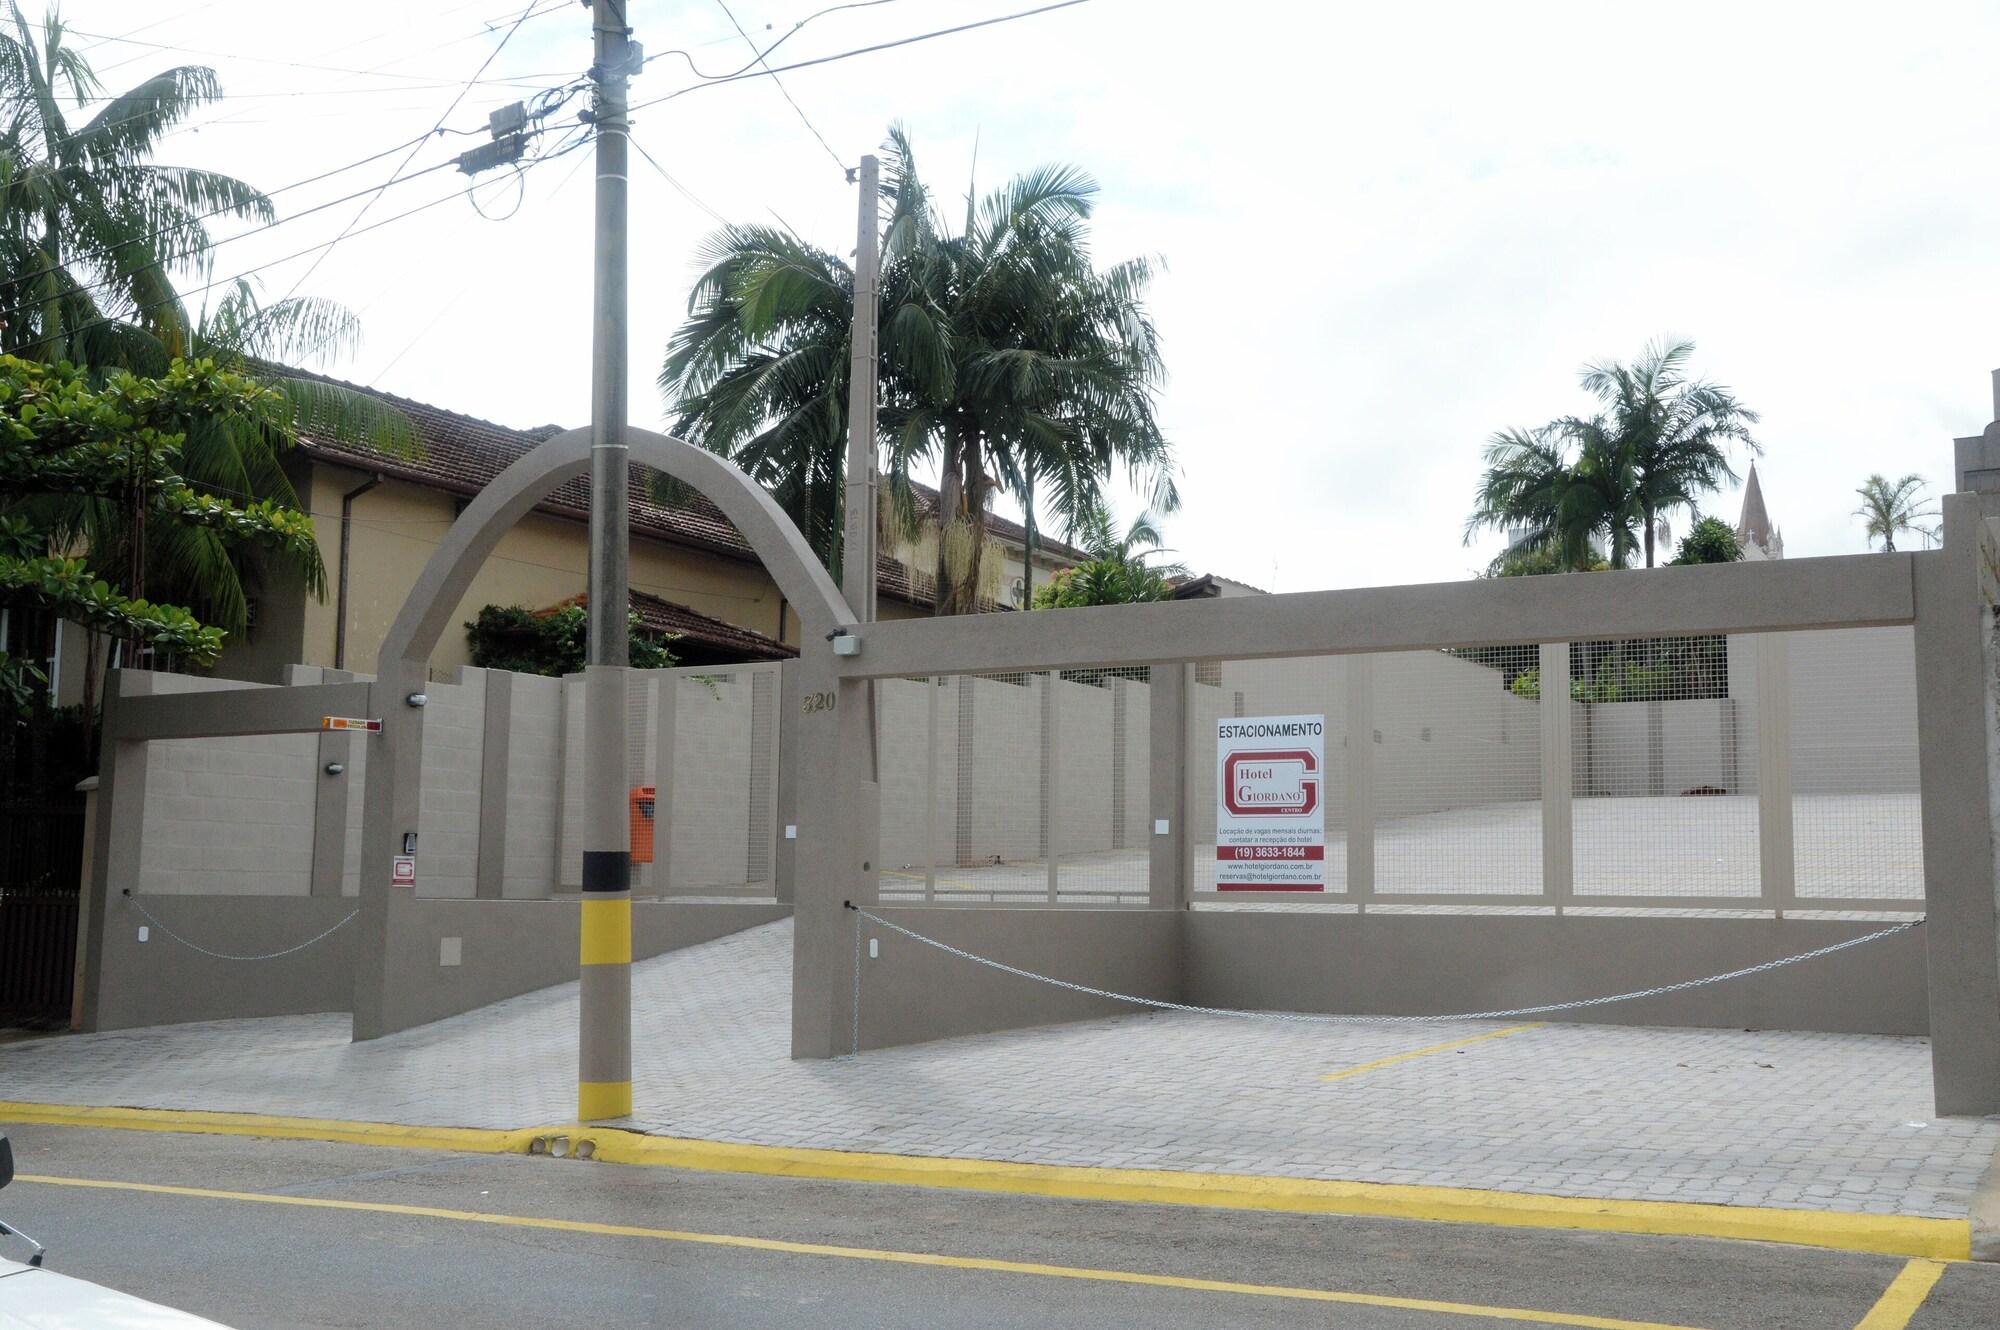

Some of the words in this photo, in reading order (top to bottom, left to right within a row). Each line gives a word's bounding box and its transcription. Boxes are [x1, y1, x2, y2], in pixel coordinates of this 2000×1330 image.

[1218, 722, 1322, 738] ESTACIONAMENTO
[1240, 768, 1273, 779] Hotel
[1238, 785, 1301, 802] GIORDANO
[1234, 847, 1254, 859] (19)
[1255, 847, 1306, 857] 3633-1844
[1228, 863, 1313, 872] www.hotelgiordano.com.br
[1219, 873, 1322, 882] reservas@hotelgiordano.com.br
